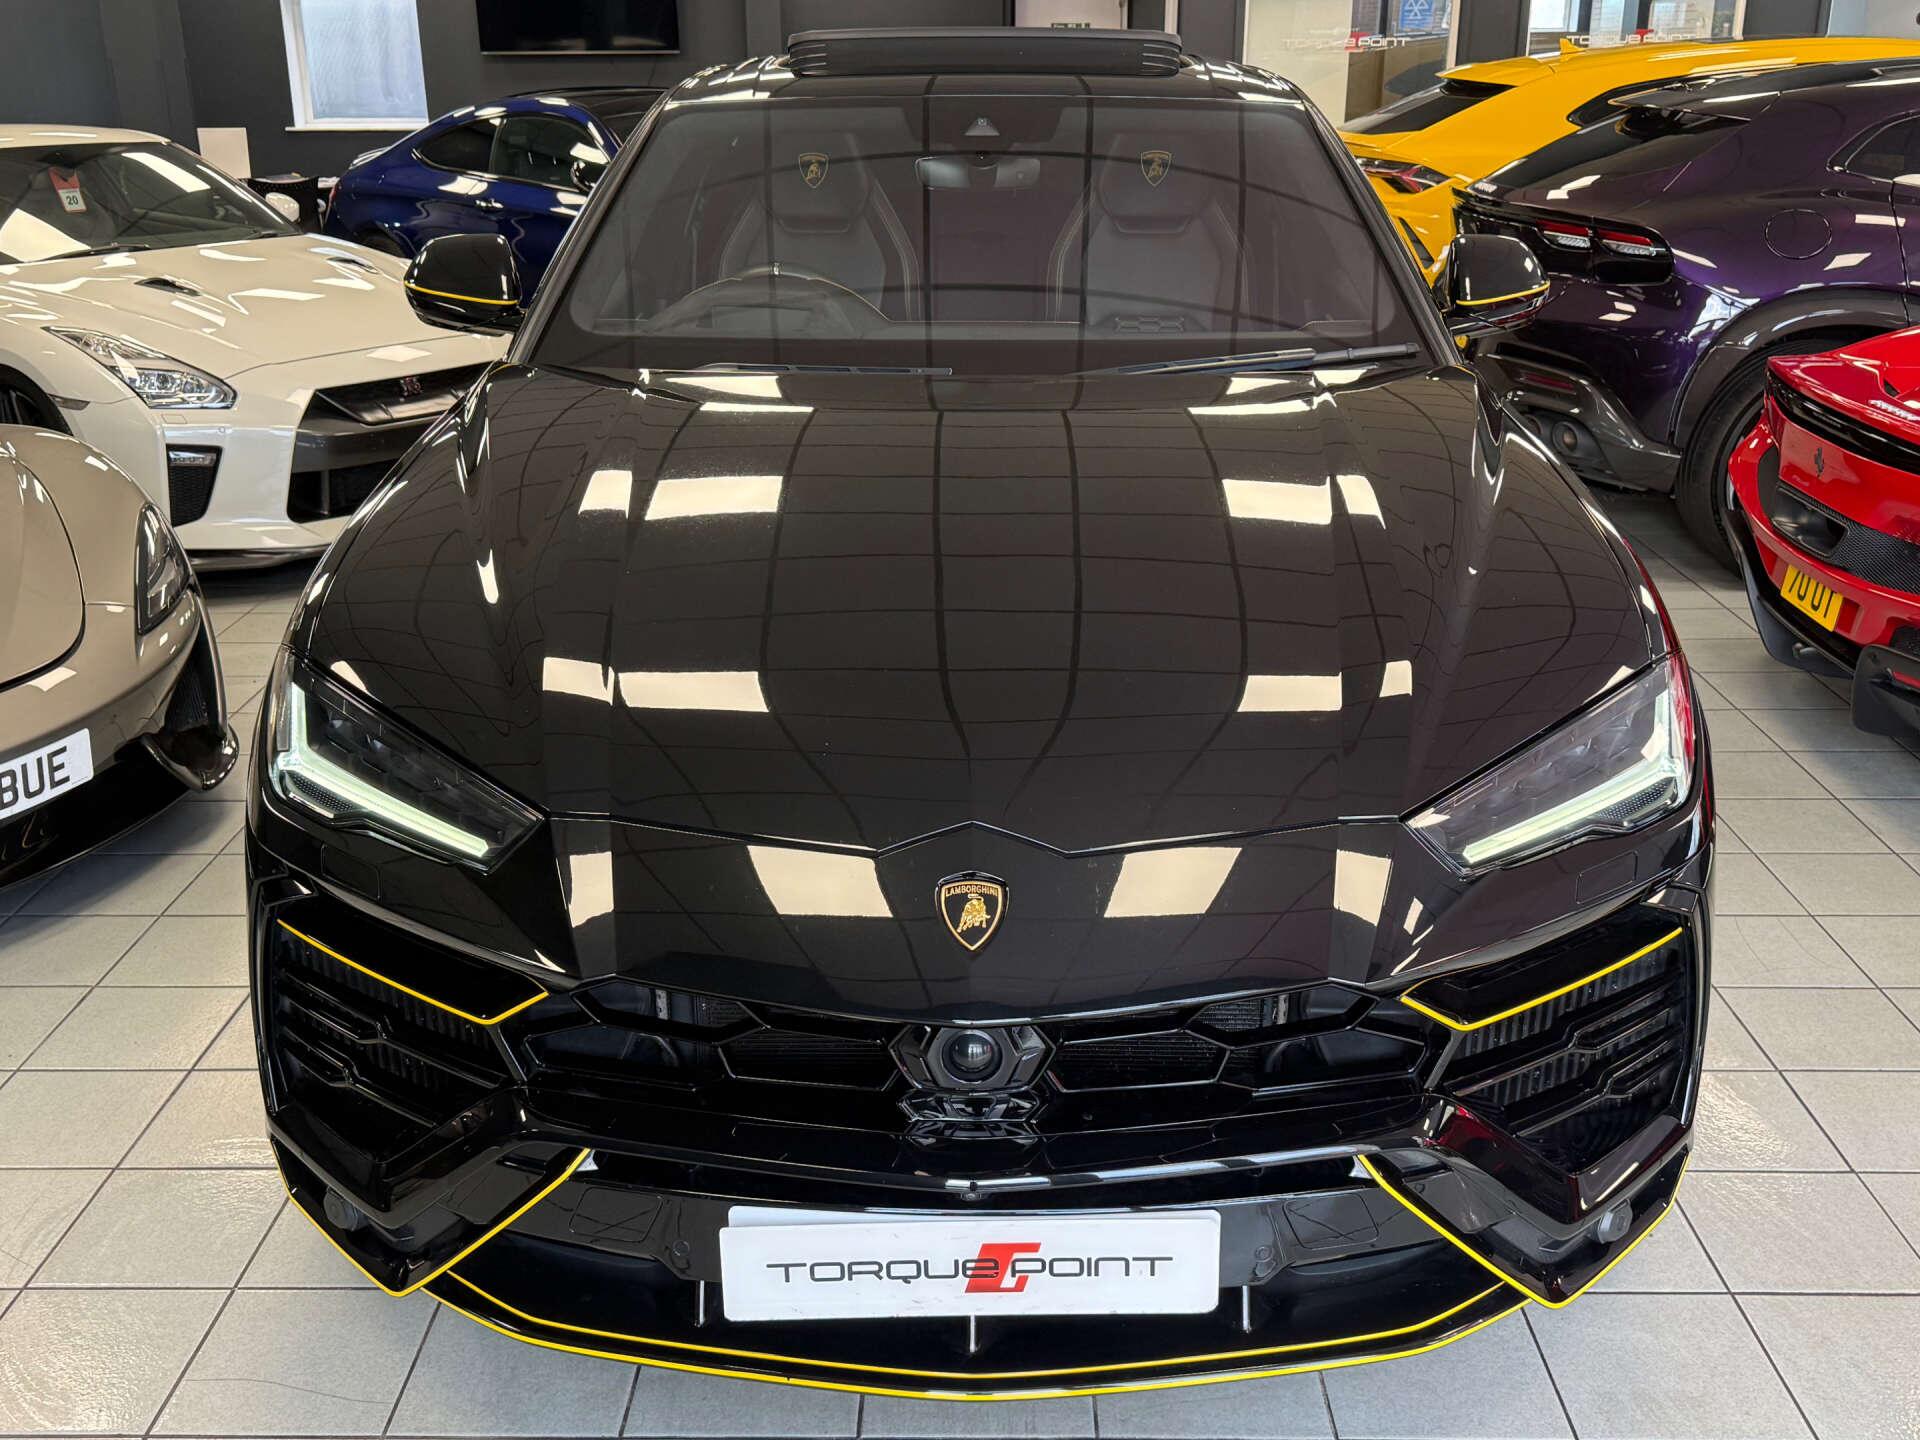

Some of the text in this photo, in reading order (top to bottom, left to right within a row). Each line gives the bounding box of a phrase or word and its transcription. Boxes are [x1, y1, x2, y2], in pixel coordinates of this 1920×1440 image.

[1358, 37, 1409, 47] POINT
[65, 195, 79, 206] 20
[945, 885, 998, 897] LAMBORGHINI
[766, 1256, 1174, 1285] TORQUE POINT
